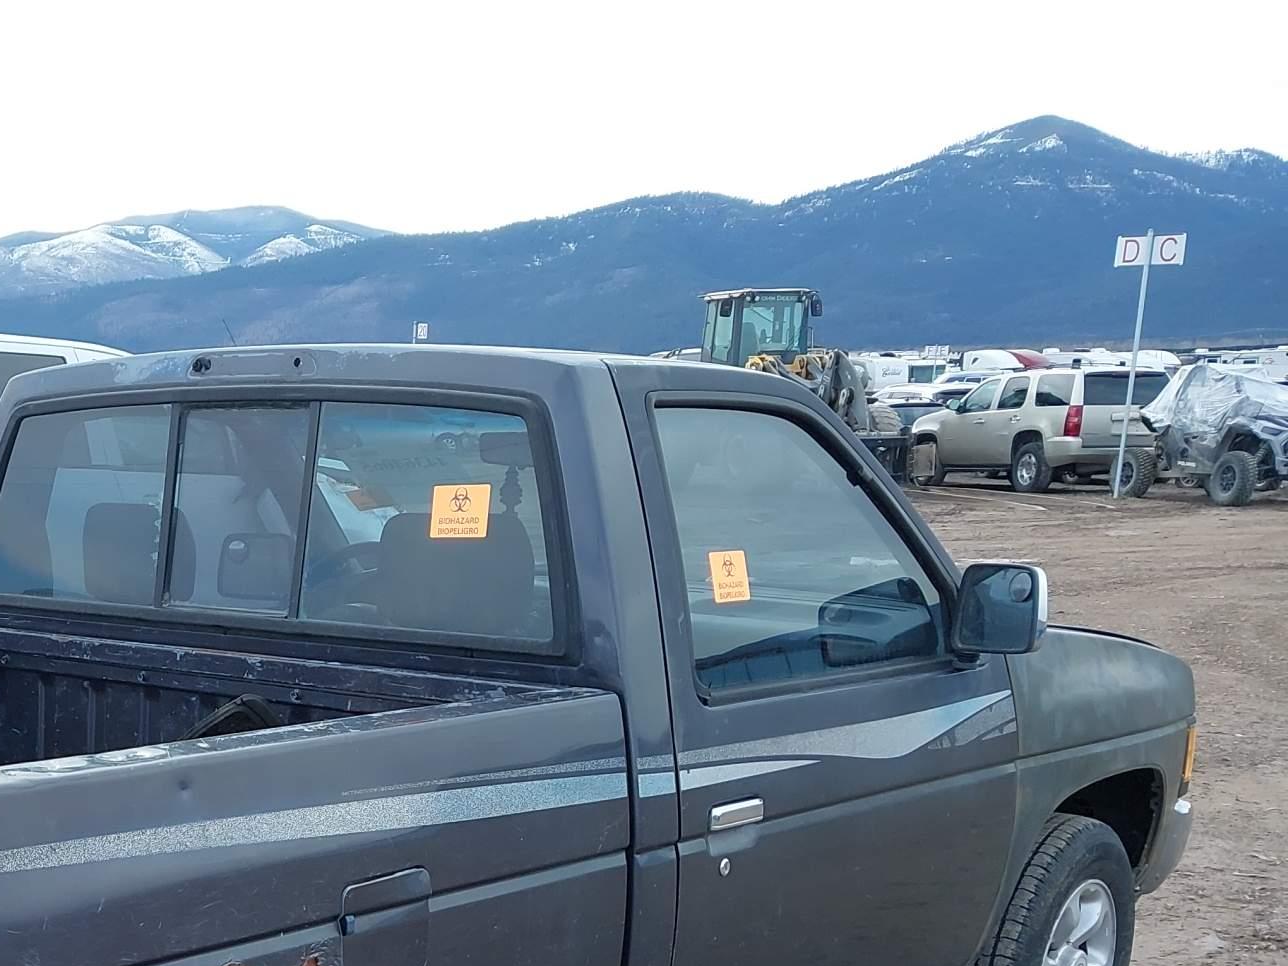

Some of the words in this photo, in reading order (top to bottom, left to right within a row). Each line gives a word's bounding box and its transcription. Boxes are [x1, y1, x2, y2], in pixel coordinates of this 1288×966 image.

[1122, 239, 1140, 263] D
[1160, 237, 1178, 262] C
[438, 517, 480, 525] BIOHAZARD
[437, 527, 479, 536] BIOPELIGRO
